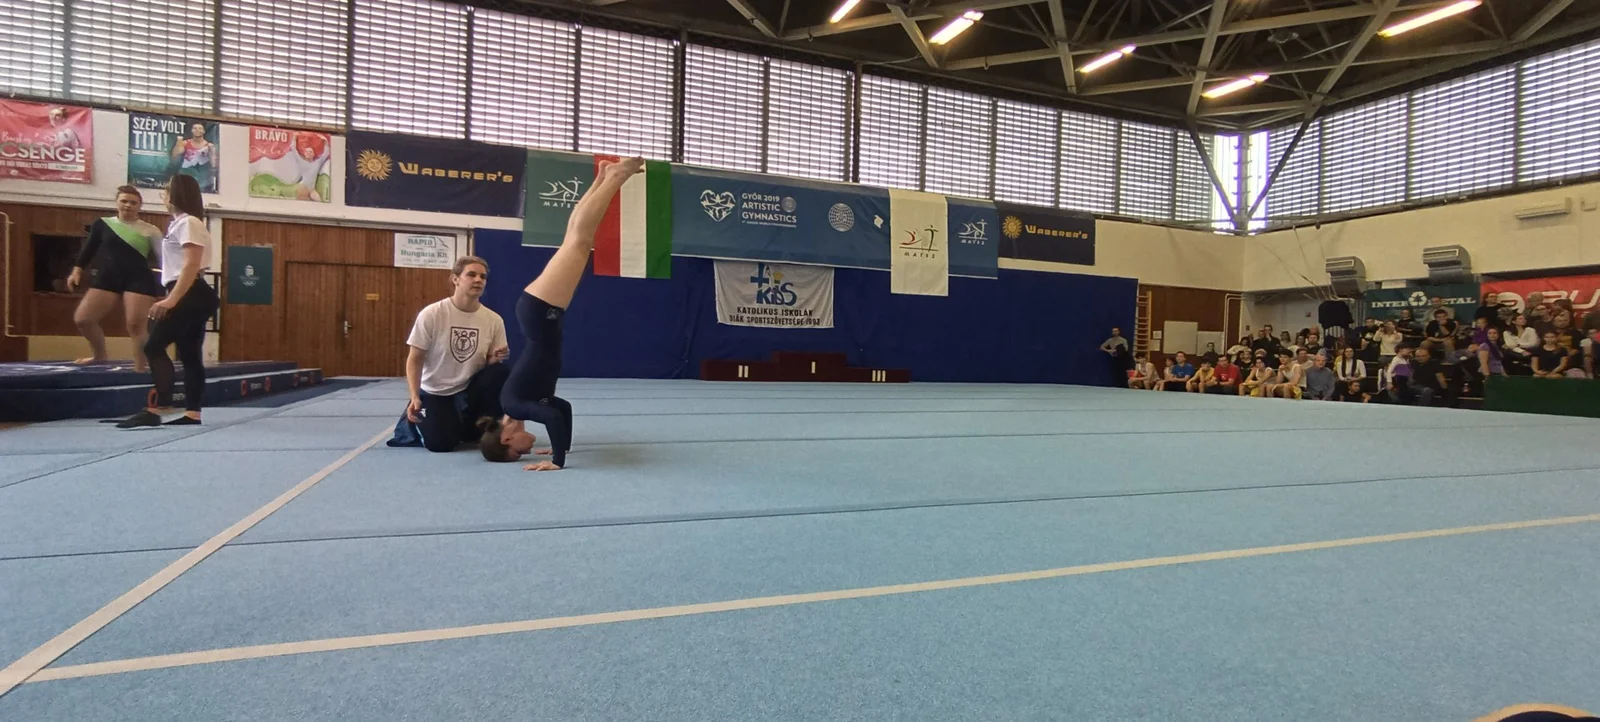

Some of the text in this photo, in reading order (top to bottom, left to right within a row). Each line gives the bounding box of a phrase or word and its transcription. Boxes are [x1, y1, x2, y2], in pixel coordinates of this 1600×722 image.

[132, 116, 186, 135] SZÉP VOLT
[132, 130, 168, 152] TITI!
[0, 141, 86, 163] CSENGE
[763, 194, 781, 203] 2019
[741, 201, 781, 212] ARTISTIC
[741, 211, 798, 224] GYMNASTICS
[407, 238, 434, 246] RAPID
[1371, 300, 1409, 308] INTER
[737, 306, 814, 317] KATOLIKUS ISKOLÁK
